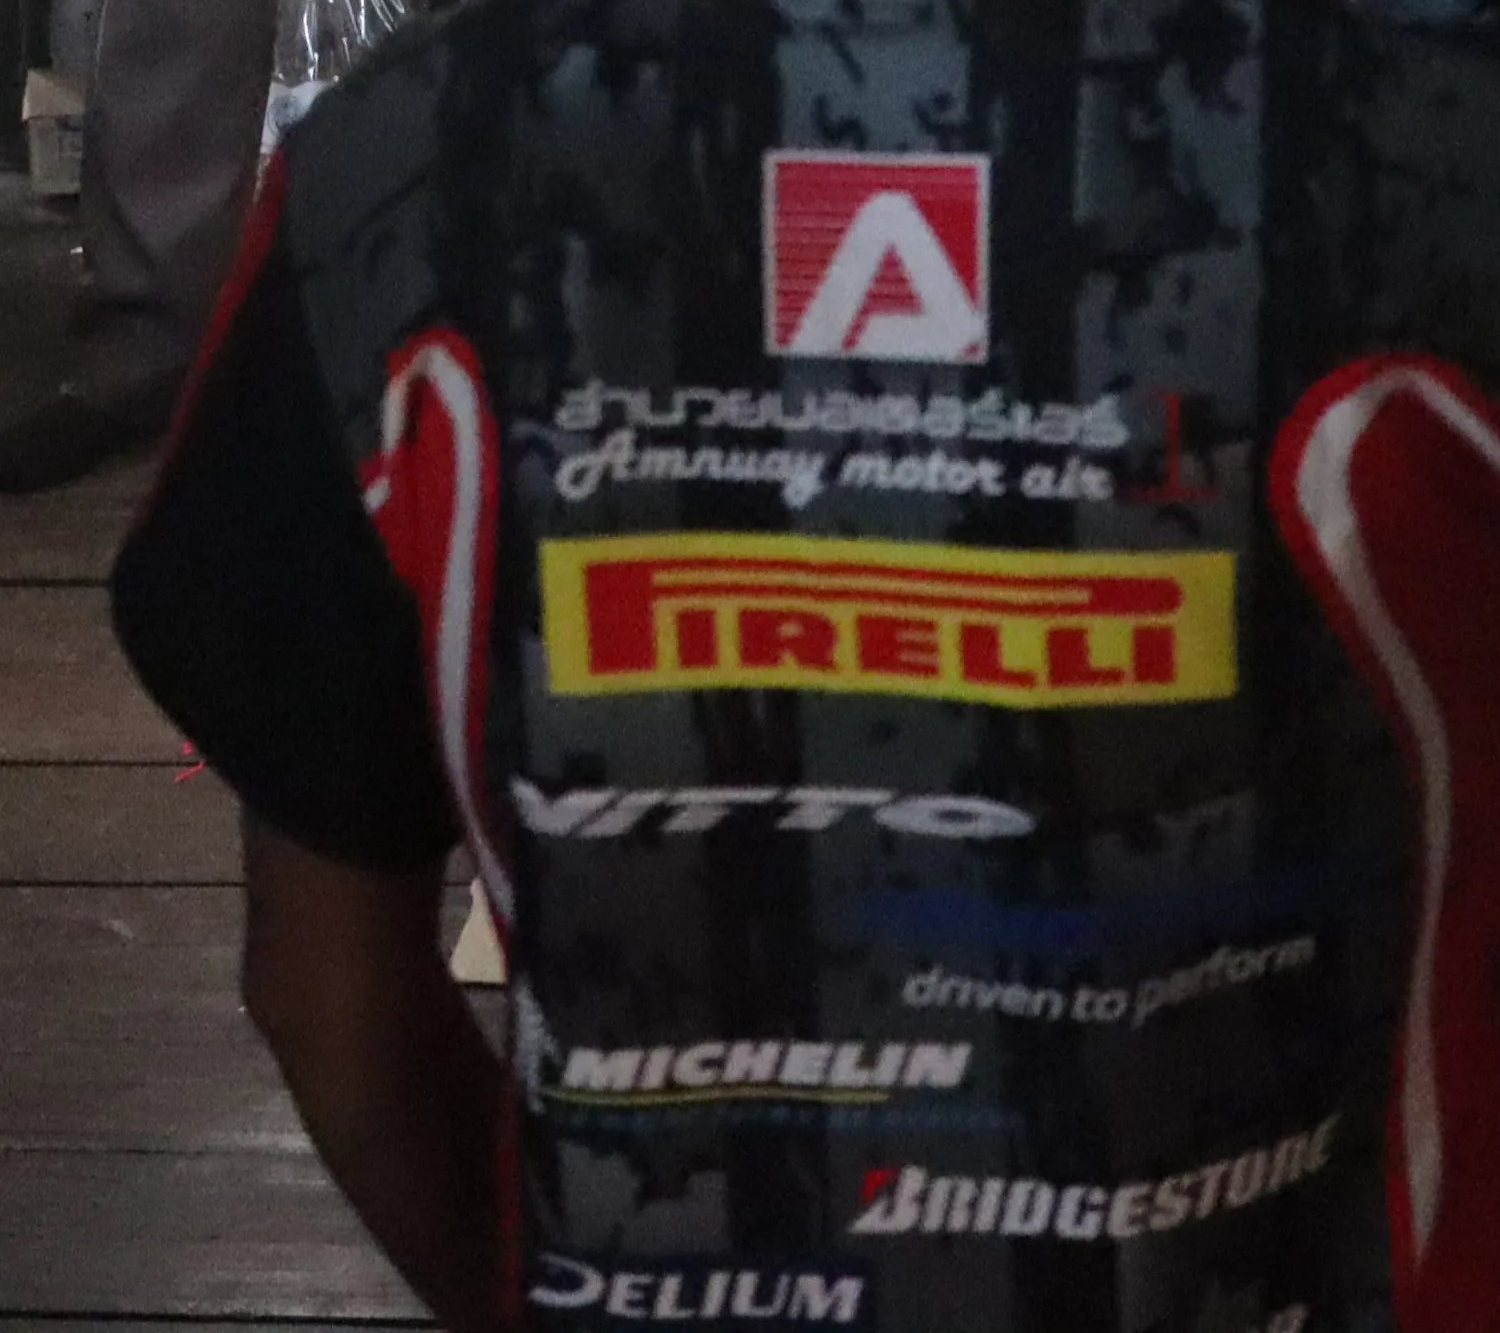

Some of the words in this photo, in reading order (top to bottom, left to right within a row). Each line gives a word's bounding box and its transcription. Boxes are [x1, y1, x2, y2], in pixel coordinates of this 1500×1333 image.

[775, 187, 989, 356] A
[554, 426, 827, 510] Amnuay
[838, 447, 1008, 499] motor
[1019, 455, 1116, 502] air
[583, 557, 1184, 688] PIRELLI
[901, 964, 1069, 1022] driven
[1070, 983, 1130, 1023] to
[1130, 933, 1318, 1030] perform
[562, 1038, 976, 1092] MICHELIN
[847, 1107, 1342, 1241] BRIDGESTONE
[526, 1250, 866, 1324] DELIUM
